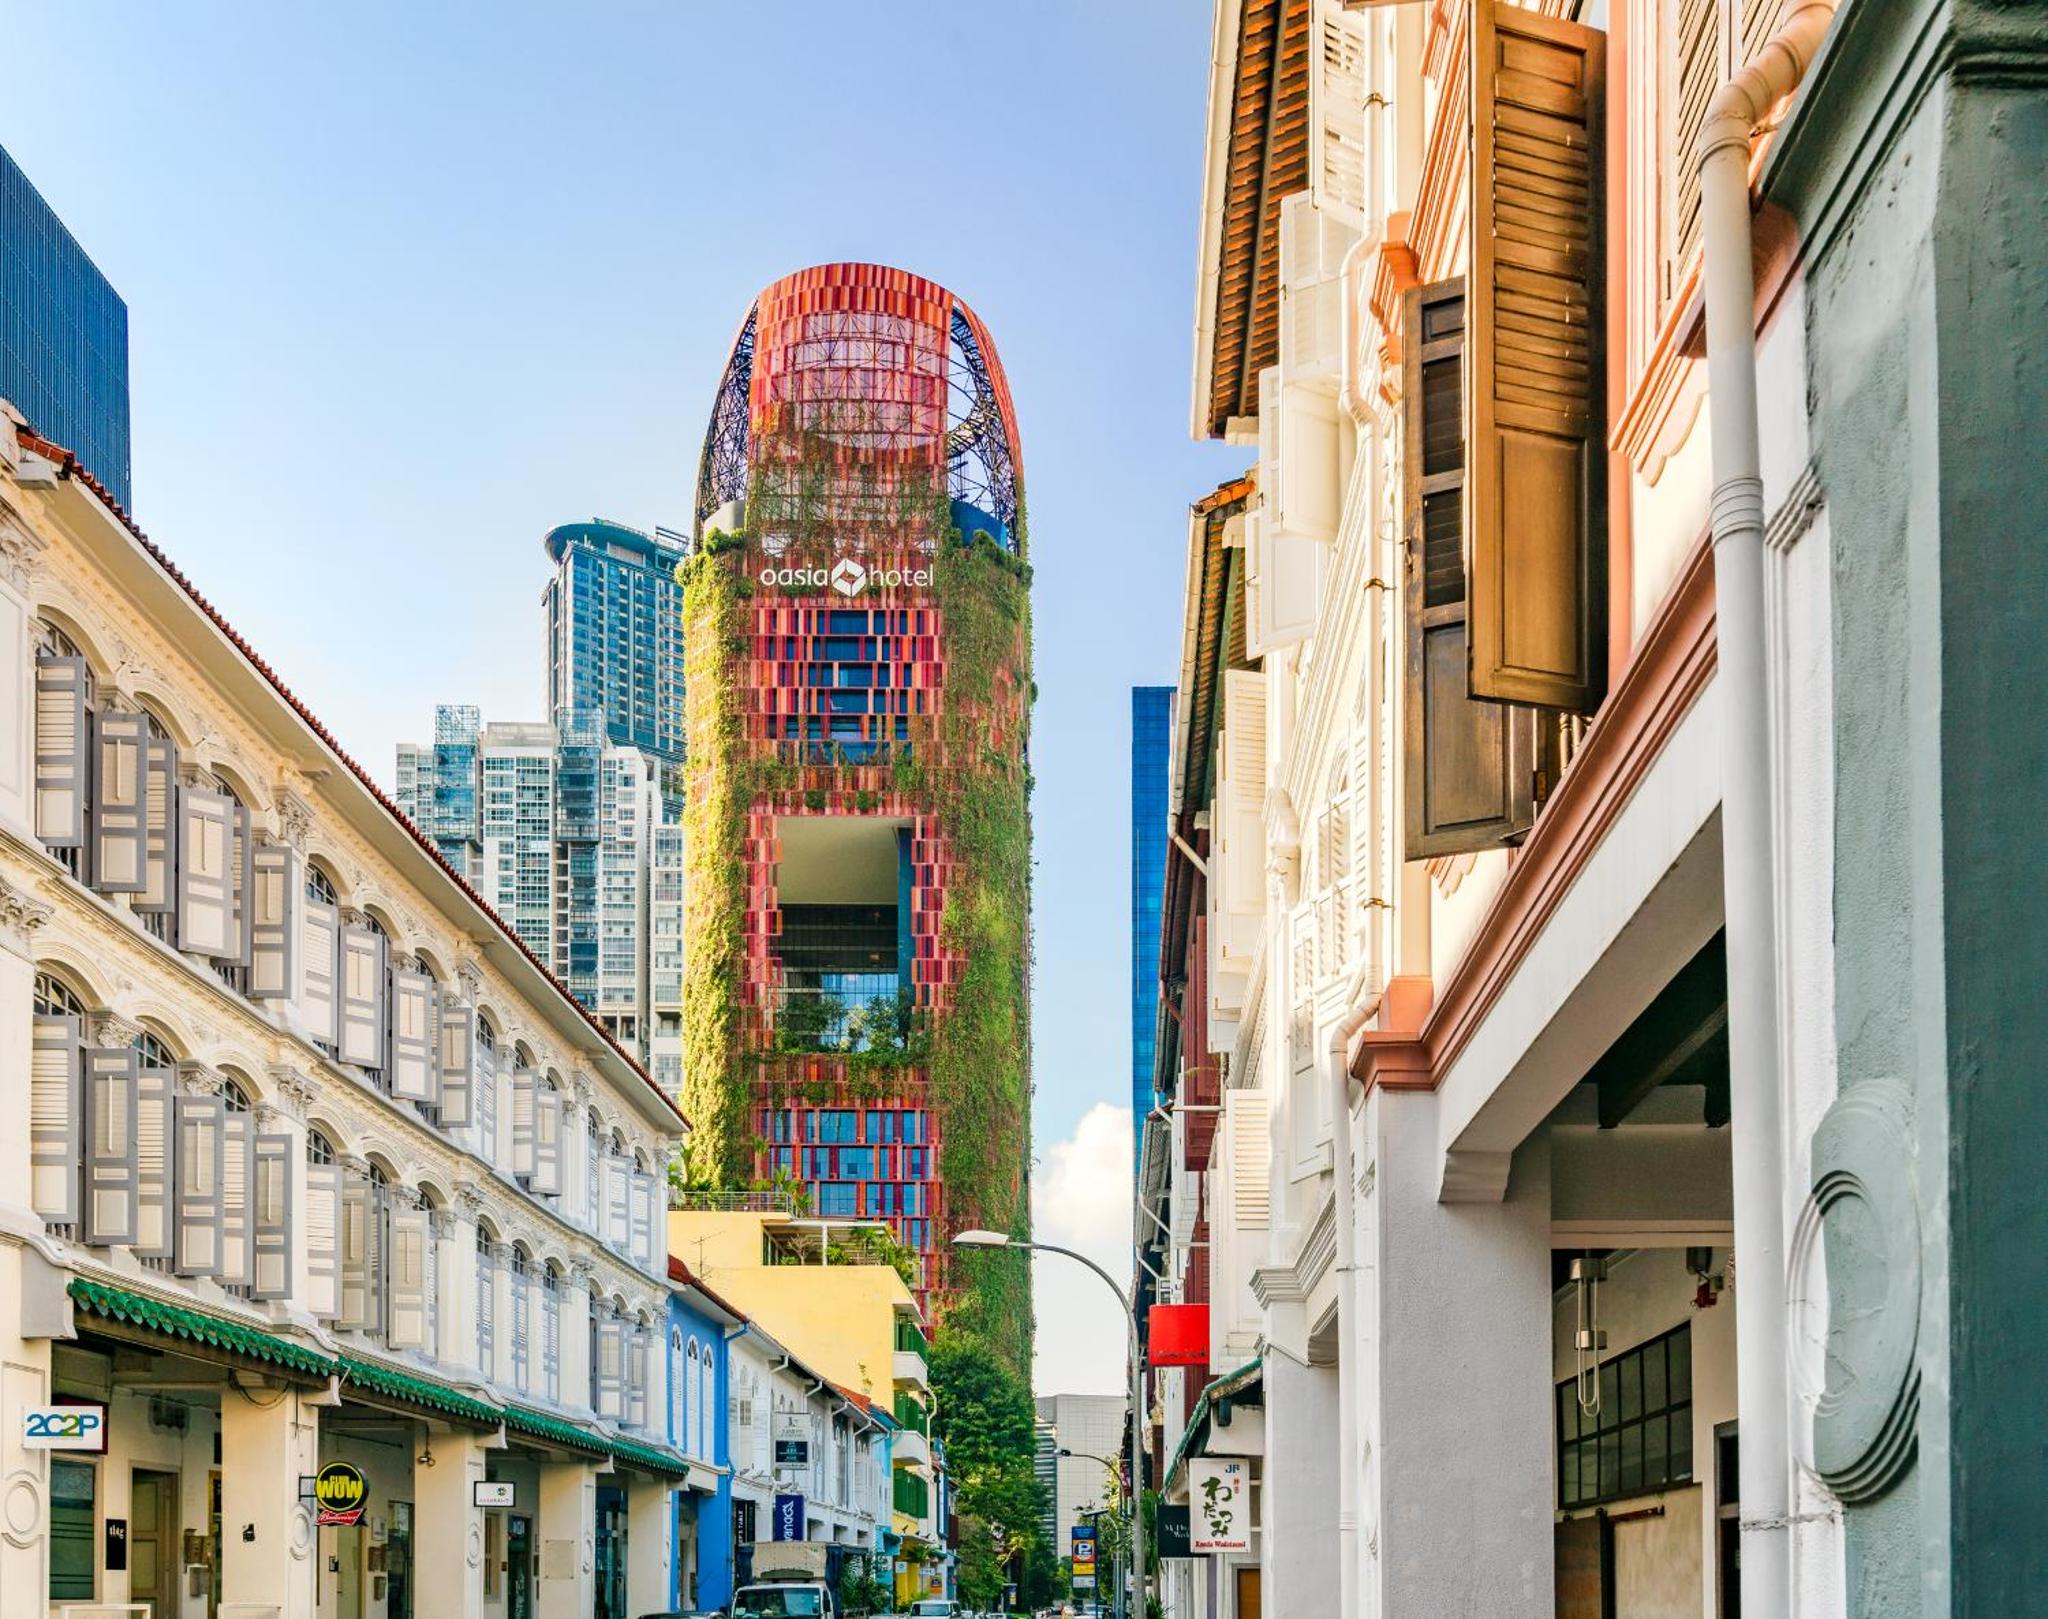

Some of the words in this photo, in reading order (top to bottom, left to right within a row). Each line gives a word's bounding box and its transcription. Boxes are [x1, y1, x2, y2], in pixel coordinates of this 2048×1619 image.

[760, 564, 828, 586] oasia
[870, 563, 934, 586] hotel
[26, 1413, 99, 1437] 2C2P
[316, 1480, 363, 1498] WOW
[1201, 1476, 1233, 1537] わだつみ
